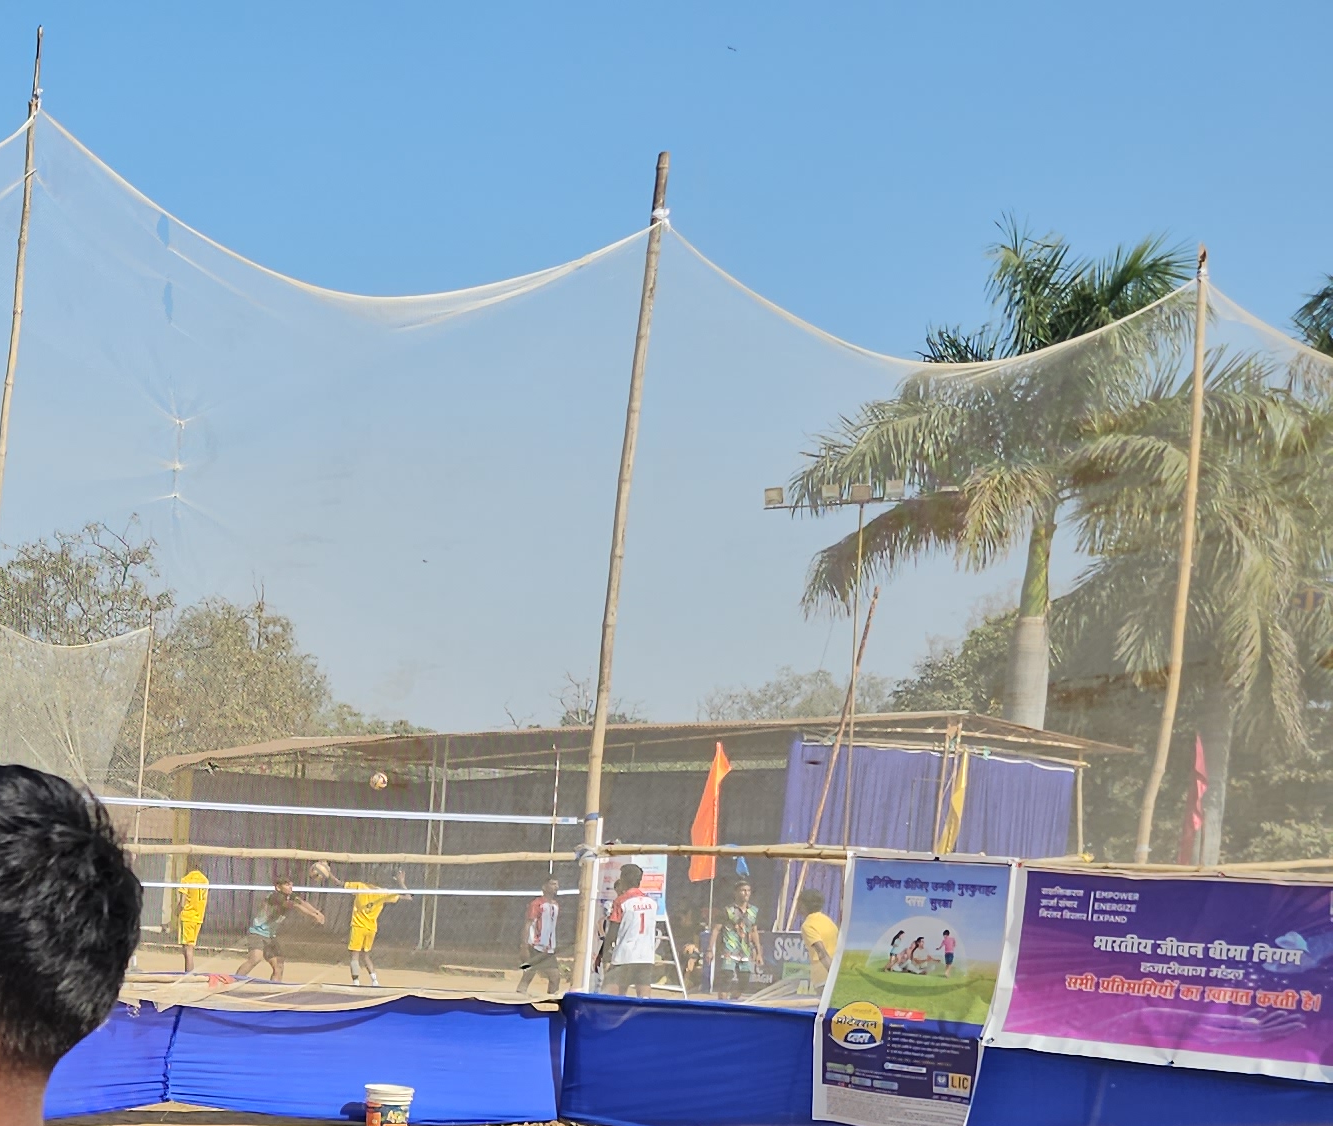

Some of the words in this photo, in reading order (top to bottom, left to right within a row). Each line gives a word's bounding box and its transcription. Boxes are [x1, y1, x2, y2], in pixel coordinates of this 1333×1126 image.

[1095, 890, 1140, 901] EMPOWER
[1094, 902, 1137, 913] ENERGIZE
[1093, 913, 1128, 923] EXPAND
[1093, 934, 1154, 955] भारतीय
[1156, 937, 1205, 959] जीवन
[1208, 940, 1249, 962] बीमा
[1252, 942, 1304, 966] निगम
[1140, 962, 1206, 978] हजारीबाग
[1209, 964, 1245, 981] मंडल
[1180, 982, 1203, 1001] का
[1256, 988, 1299, 1010] करती
[951, 1075, 969, 1090] LIC
